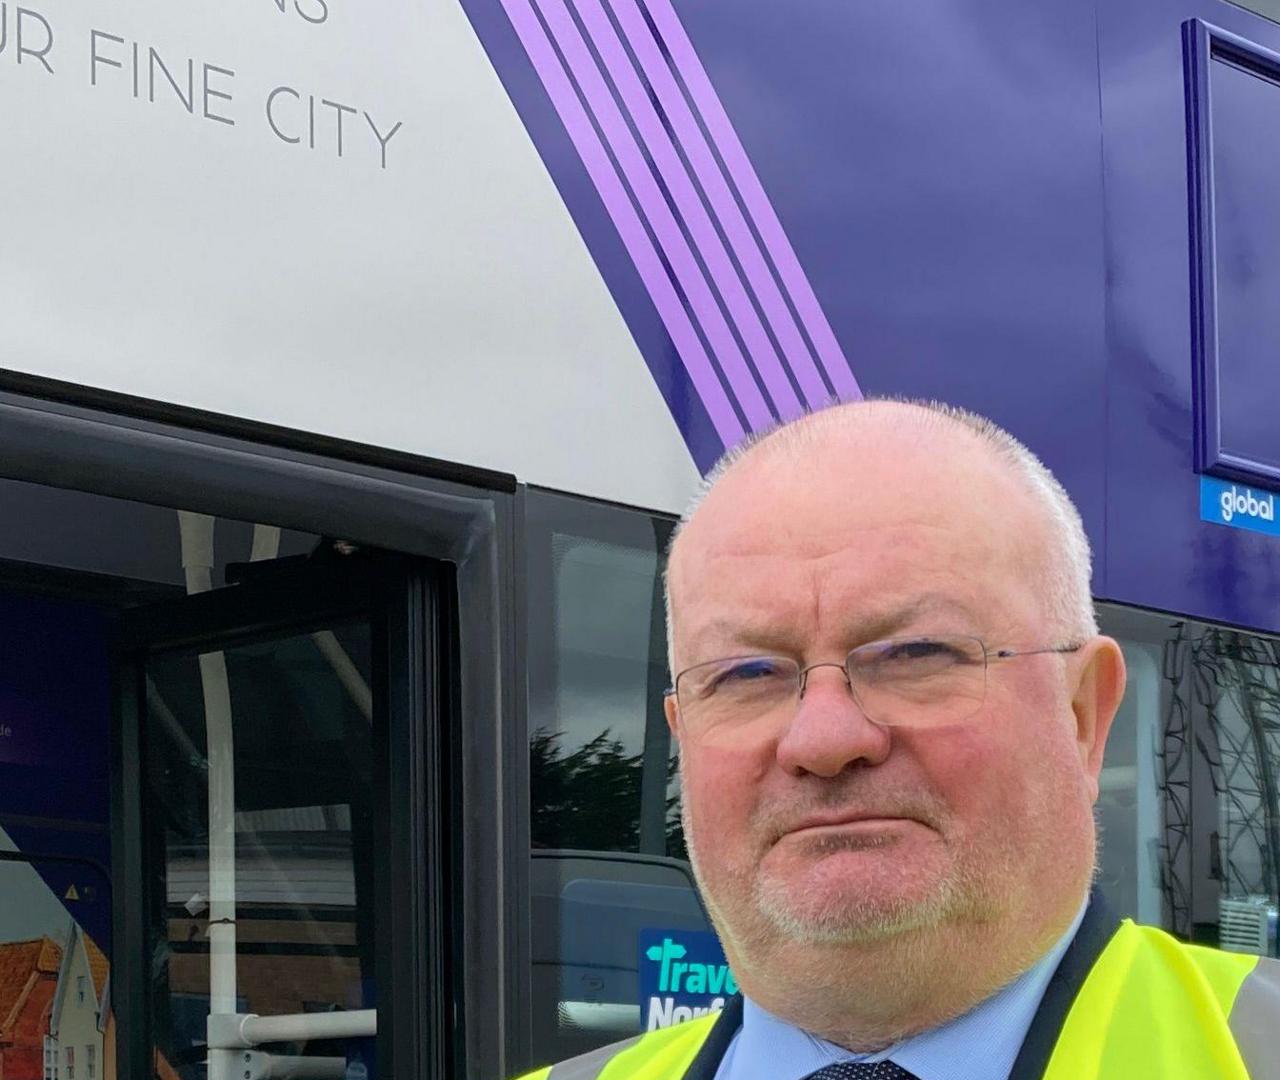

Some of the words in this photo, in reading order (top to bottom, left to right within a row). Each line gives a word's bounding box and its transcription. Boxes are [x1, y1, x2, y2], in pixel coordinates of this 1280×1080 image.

[91, 29, 236, 126] FINE
[266, 86, 403, 169] CITY
[1220, 485, 1274, 521] global
[646, 938, 741, 995] Trave
